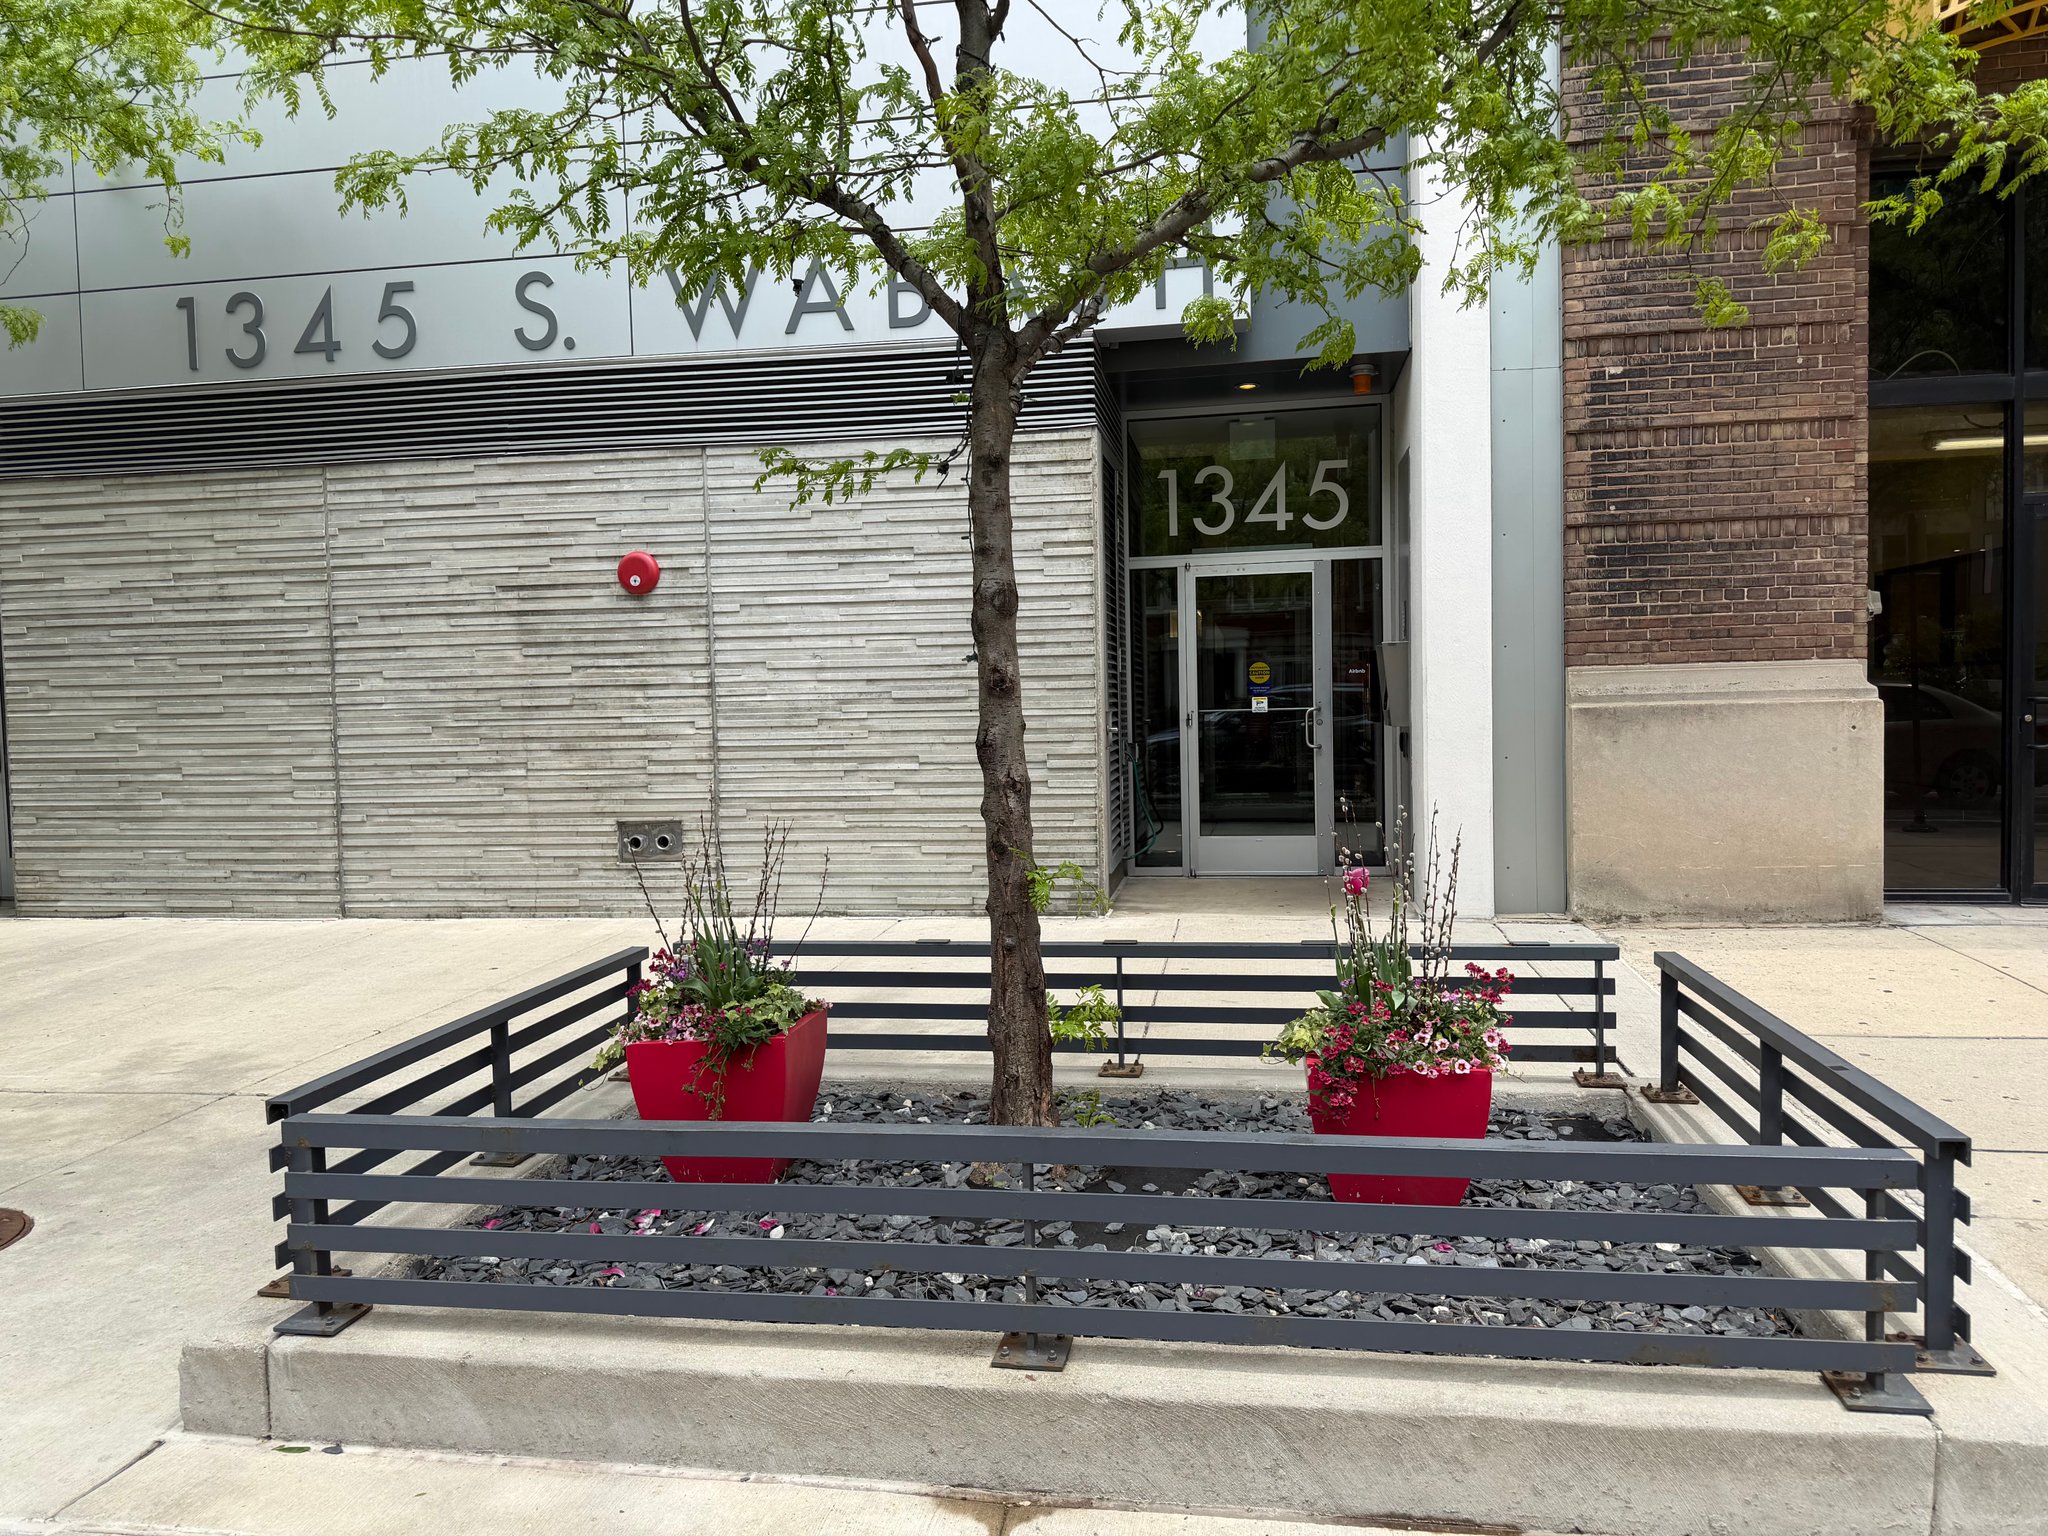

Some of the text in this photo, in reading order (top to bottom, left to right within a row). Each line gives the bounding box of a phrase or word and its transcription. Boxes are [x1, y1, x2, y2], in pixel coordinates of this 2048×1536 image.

[176, 242, 1214, 371] 1345 S. WABH
[1157, 459, 1349, 537] 1345
